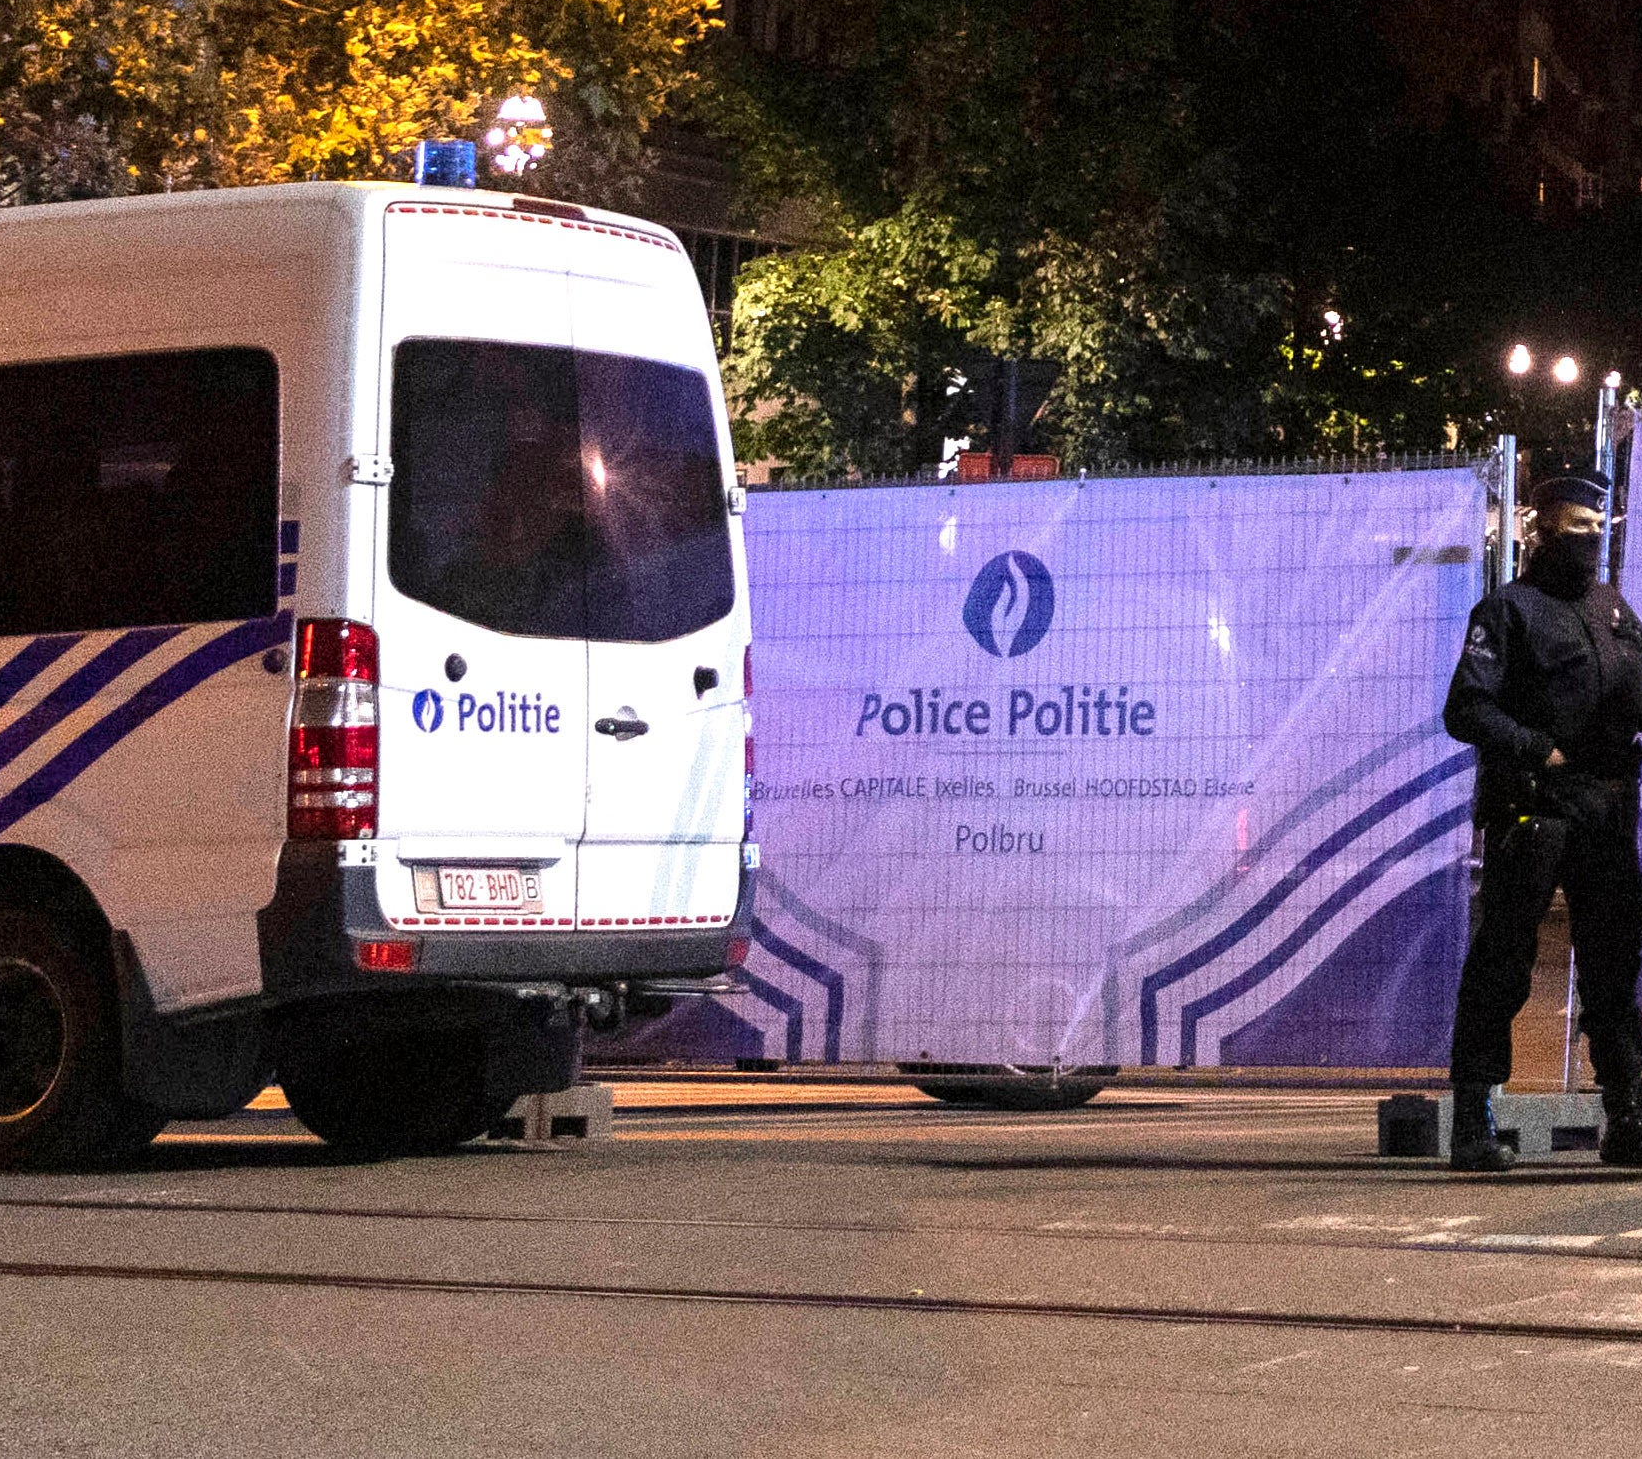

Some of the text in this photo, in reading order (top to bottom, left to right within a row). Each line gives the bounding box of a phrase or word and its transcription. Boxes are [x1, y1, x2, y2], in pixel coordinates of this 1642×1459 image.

[459, 690, 561, 734] Politie
[857, 685, 1156, 737] Police Politie
[840, 776, 927, 798] CAPITALE
[1014, 778, 1077, 798] Brussel
[1084, 777, 1198, 798] HOOFDSTAD
[955, 824, 1045, 854] Polbru
